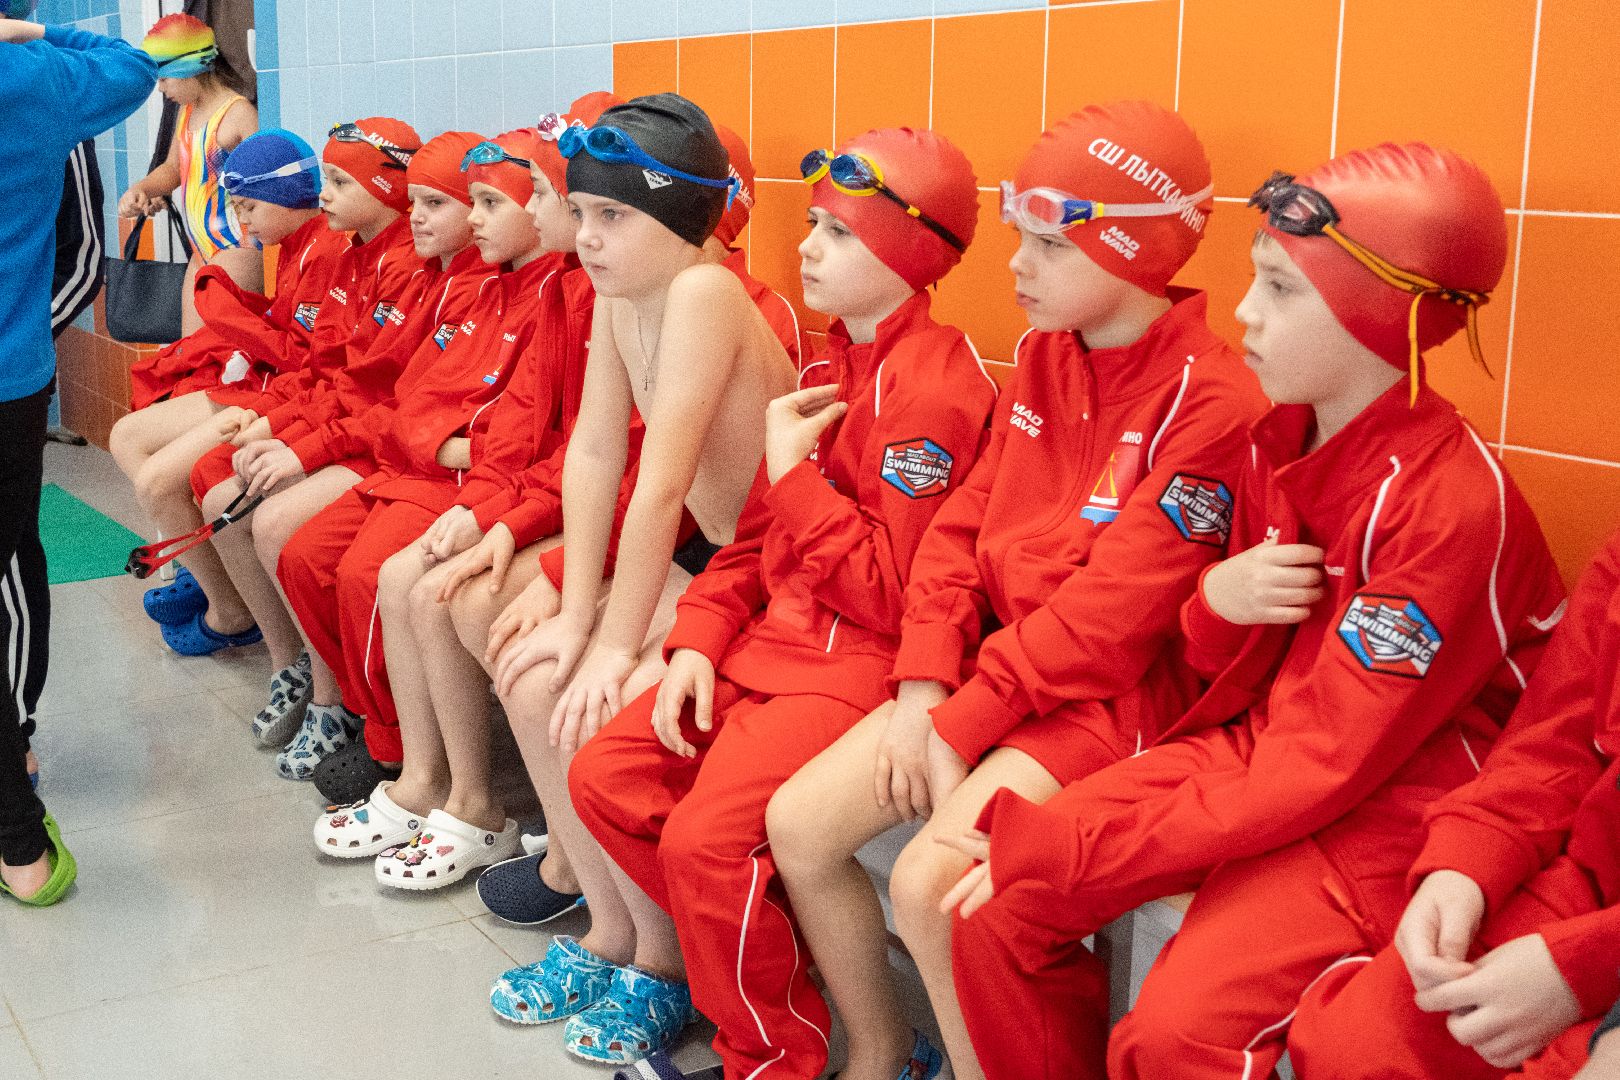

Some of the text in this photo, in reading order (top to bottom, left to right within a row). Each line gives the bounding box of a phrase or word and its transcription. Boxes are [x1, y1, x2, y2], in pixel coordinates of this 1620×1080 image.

[1087, 138, 1126, 166] СШ
[1099, 230, 1137, 261] WAVE
[1107, 225, 1141, 252] MAD
[886, 458, 950, 479] SWIMMING
[1348, 609, 1433, 662] SWIMMING
